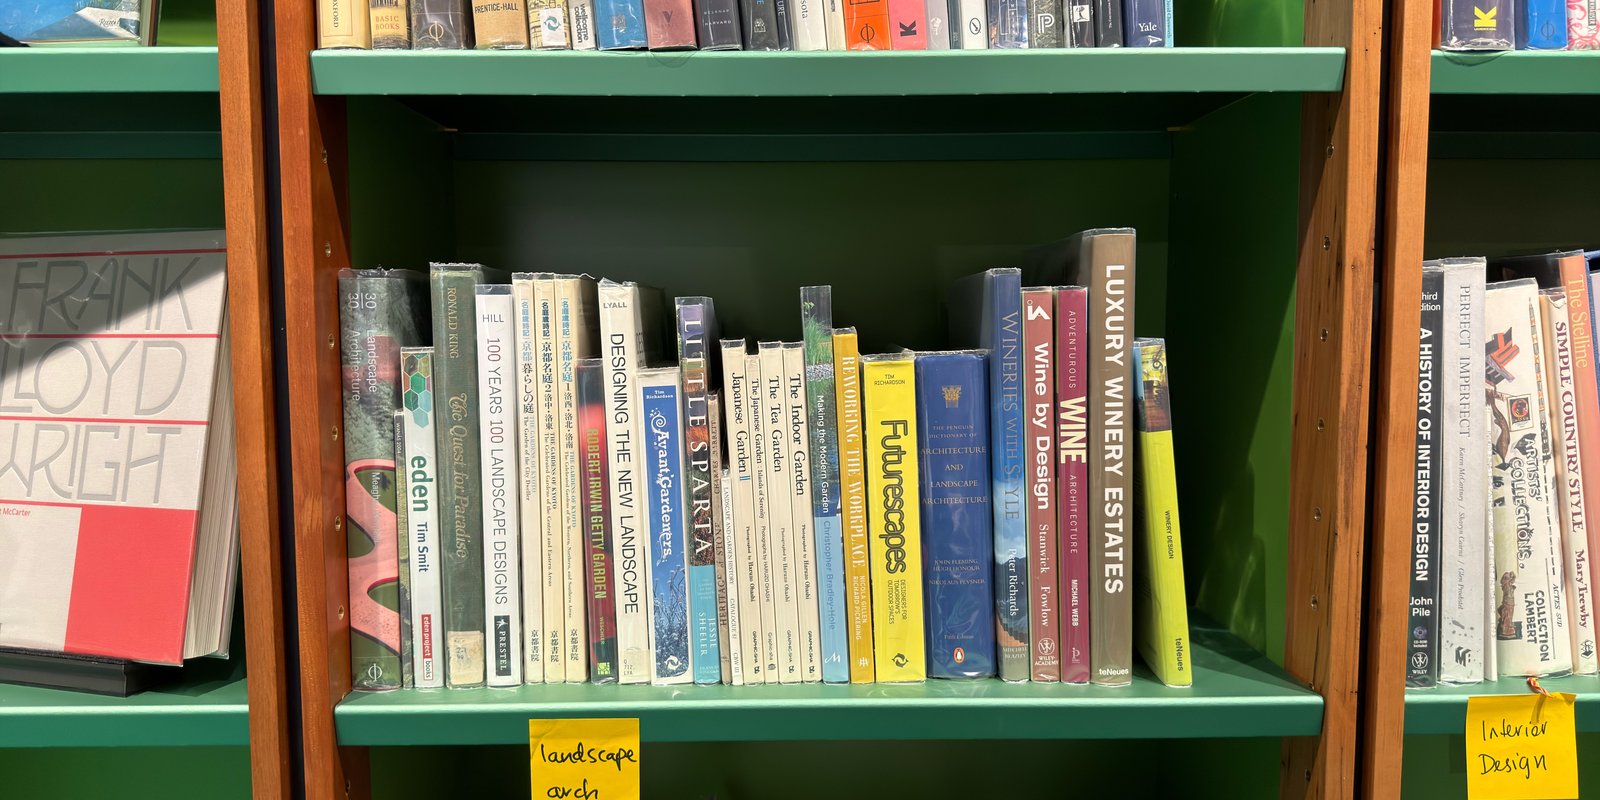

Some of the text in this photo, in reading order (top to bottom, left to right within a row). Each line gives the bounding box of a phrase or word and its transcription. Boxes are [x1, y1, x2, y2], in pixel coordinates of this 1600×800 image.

[376, 15, 399, 23] BASIC
[376, 23, 400, 31] BOOKS
[474, 2, 519, 15] PRENTICE-HALL
[574, 6, 582, 43] collection
[581, 3, 589, 40] wellcome
[1138, 22, 1157, 32] Yale
[8, 257, 201, 332] FRANK
[447, 287, 459, 359] RONALD KING
[483, 314, 504, 323] HILL
[1567, 275, 1589, 368] The Stelline
[348, 292, 363, 402] 30 Architecture
[365, 292, 380, 394] 30 Landscape
[1459, 286, 1471, 438] PERFECT IMPERFECT
[684, 320, 706, 427] LITTLE
[751, 379, 759, 395] The
[731, 373, 744, 424] Japanese
[750, 397, 760, 431] Japanese
[817, 395, 826, 426] Making
[769, 376, 783, 472] The Tea Garden
[790, 374, 806, 496] The Indoor Garden
[1033, 343, 1050, 509] Wine by Design
[1060, 396, 1086, 463] WINE
[1105, 265, 1125, 593] LUXURY WINERY ESTATES
[488, 338, 507, 604] 100 YEARS 100 LANDSCAPE DESIGNS
[736, 431, 749, 473] Garden
[819, 446, 827, 479] Modern
[842, 356, 865, 568] REWORKING THE WORKPLACE
[921, 447, 986, 455] ARCHITECTURE
[1416, 328, 1432, 581] A HISTORY OF INTERIOR DESIGN
[448, 392, 472, 559] The Quest for Paradise
[611, 334, 639, 614] DESIGNING THE NEW LANDSCAPE
[930, 480, 977, 488] LANDSCAPE
[1004, 464, 1020, 520] STYLE
[1458, 468, 1466, 502] McCartney
[1555, 322, 1589, 628] SIMPLE COUNTRY STYLE Mary Trewby
[3, 508, 32, 520] McCarter
[411, 456, 434, 573] eden Tim Smit
[587, 428, 606, 599] ROBERT IRWIN GETTY GARDEN
[690, 442, 712, 554] SPARTA
[879, 420, 908, 574] Futurescapes
[922, 497, 988, 505] ARCHITECTURE
[1069, 475, 1078, 554] ARCHITECTURE
[1164, 510, 1172, 534] WINERY
[823, 521, 831, 570] Christopher
[1008, 548, 1018, 616] Peter Richards
[1039, 524, 1050, 626] Stanwick Fowlow
[1552, 584, 1560, 609] ACTES
[825, 574, 835, 629] Bradley-Hole
[1410, 596, 1433, 606] John
[1412, 608, 1431, 616] Pile
[1525, 592, 1537, 644] LAMBERT
[423, 633, 432, 656] project
[698, 613, 707, 655] SHEELER
[708, 618, 716, 649] JESSIE
[1535, 590, 1549, 662] COLLECTION
[499, 631, 507, 670] PRESTEL
[1099, 668, 1129, 676] teNeues
[1175, 638, 1184, 671] teNeues
[1482, 718, 1548, 741] Interior
[541, 742, 639, 771] landscape
[1478, 753, 1546, 780] Design
[547, 778, 599, 800] arch
